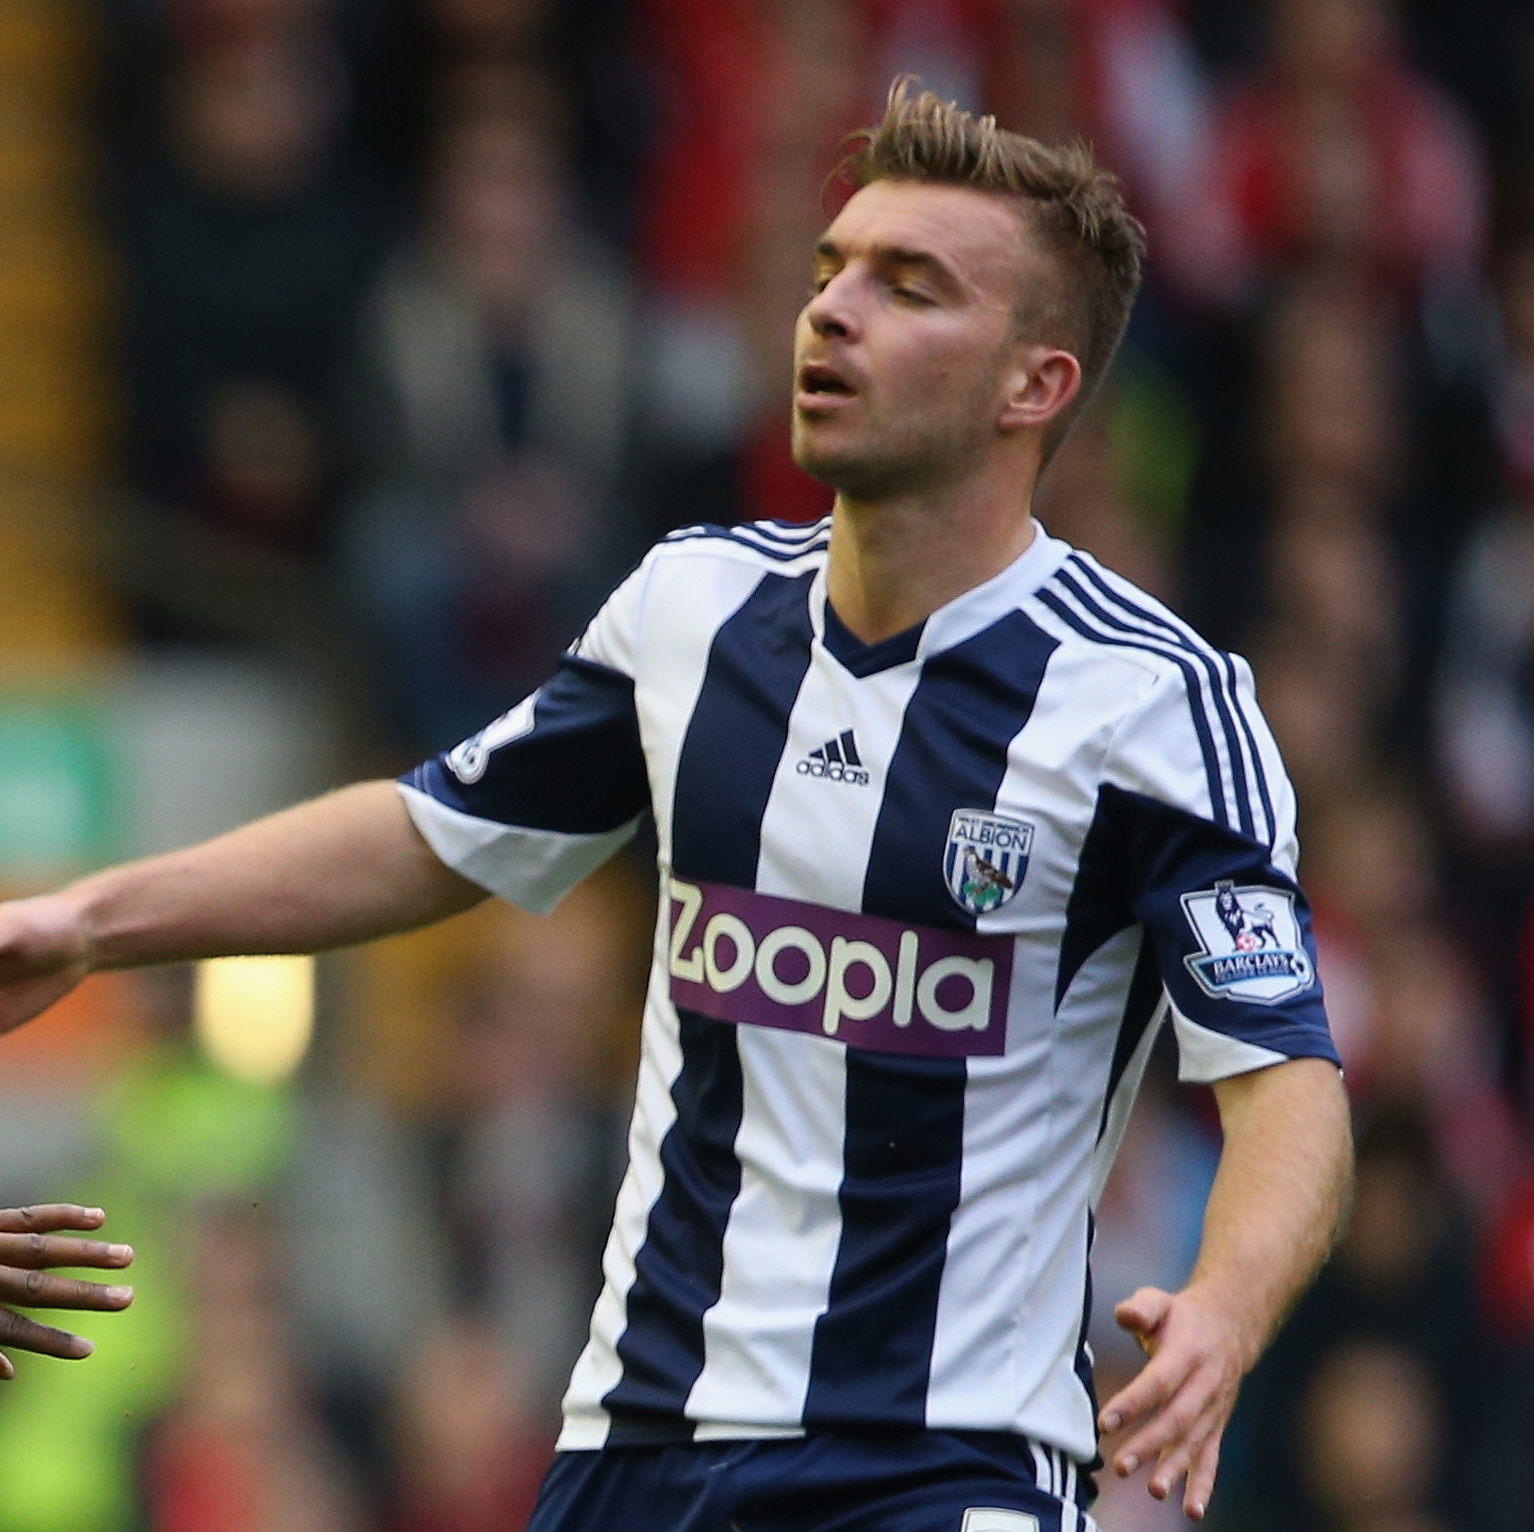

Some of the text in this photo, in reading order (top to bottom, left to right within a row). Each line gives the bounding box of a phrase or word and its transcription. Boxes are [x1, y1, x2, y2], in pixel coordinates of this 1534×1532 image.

[796, 756, 869, 787] adidas
[955, 822, 1028, 851] ALBION
[669, 877, 995, 1036] Zoopla
[1213, 952, 1288, 976] BARCLAYS
